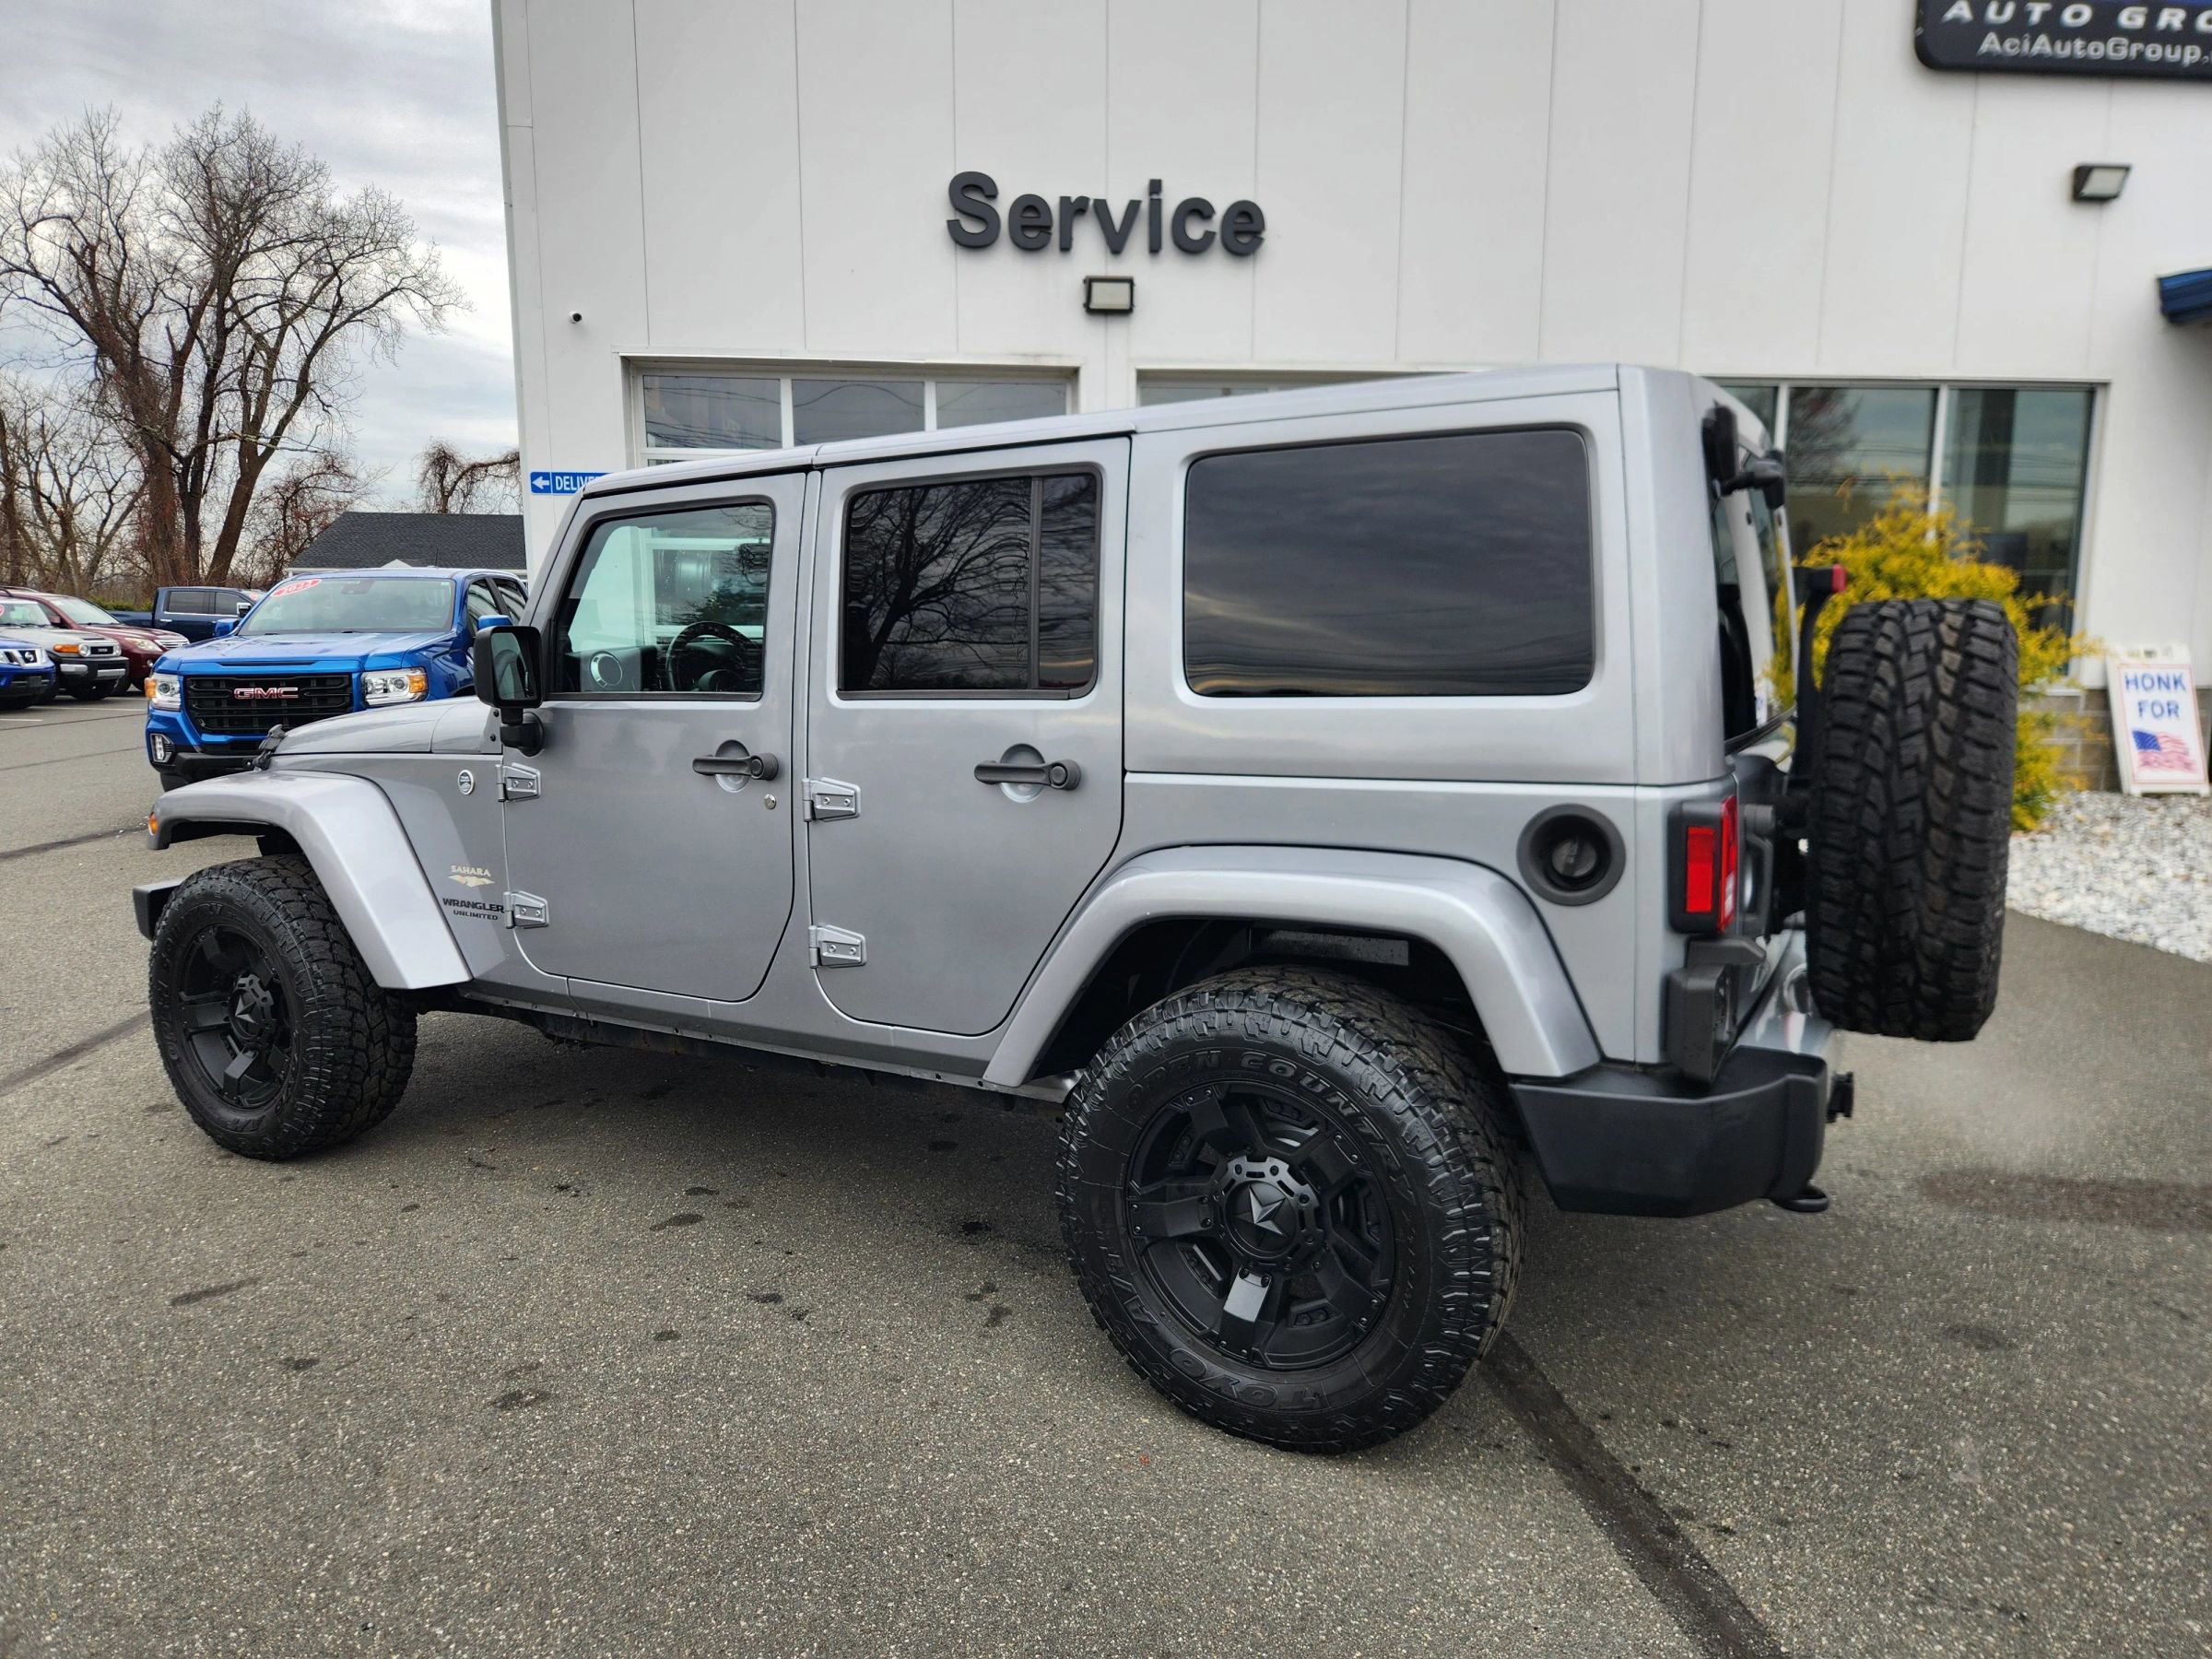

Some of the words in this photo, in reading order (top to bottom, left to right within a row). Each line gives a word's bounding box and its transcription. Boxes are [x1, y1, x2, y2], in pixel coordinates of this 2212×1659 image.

[1940, 0, 2093, 27] AUTO
[947, 171, 1265, 256] Service
[2124, 672, 2187, 691] HONK
[233, 687, 299, 700] GMC
[2136, 700, 2180, 719] FOR
[450, 865, 492, 877] SAHARA
[441, 897, 505, 914] WRANGLER
[453, 909, 499, 922] UNLIMITED
[1124, 1049, 1223, 1112] OPEN
